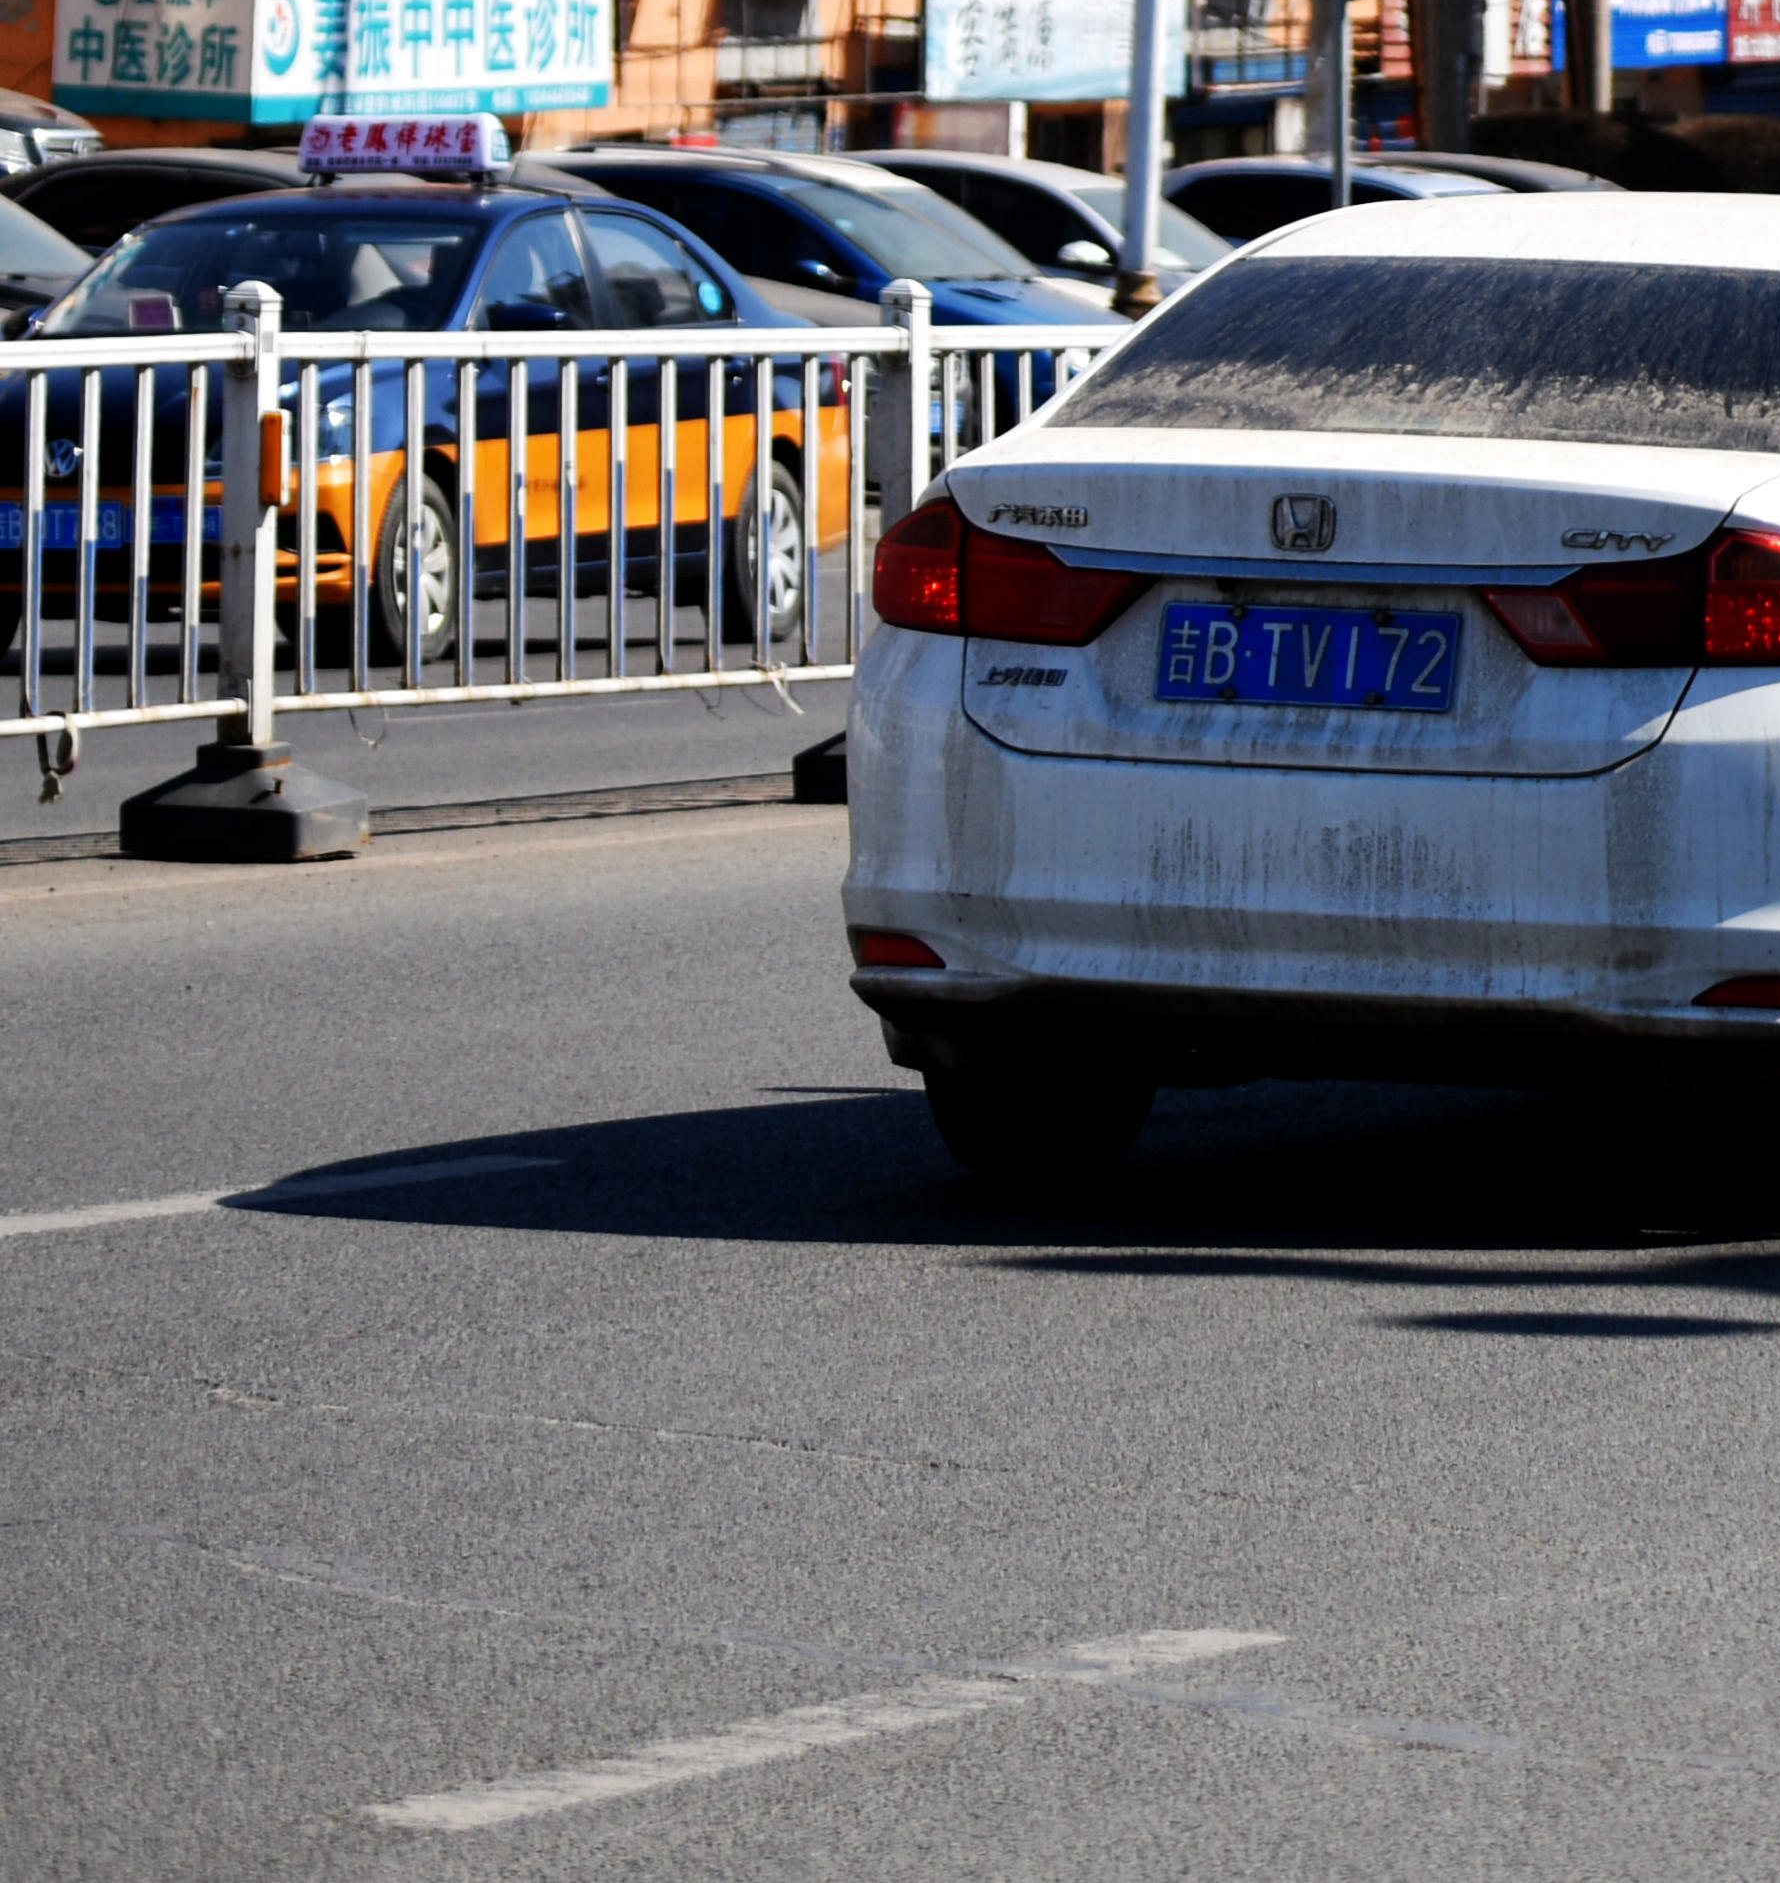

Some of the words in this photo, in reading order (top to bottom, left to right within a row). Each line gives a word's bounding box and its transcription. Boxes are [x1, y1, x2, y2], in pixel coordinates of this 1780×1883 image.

[68, 15, 239, 86] 中医诊所
[988, 503, 1088, 528] 广汽本田
[1561, 528, 1677, 553] CITY
